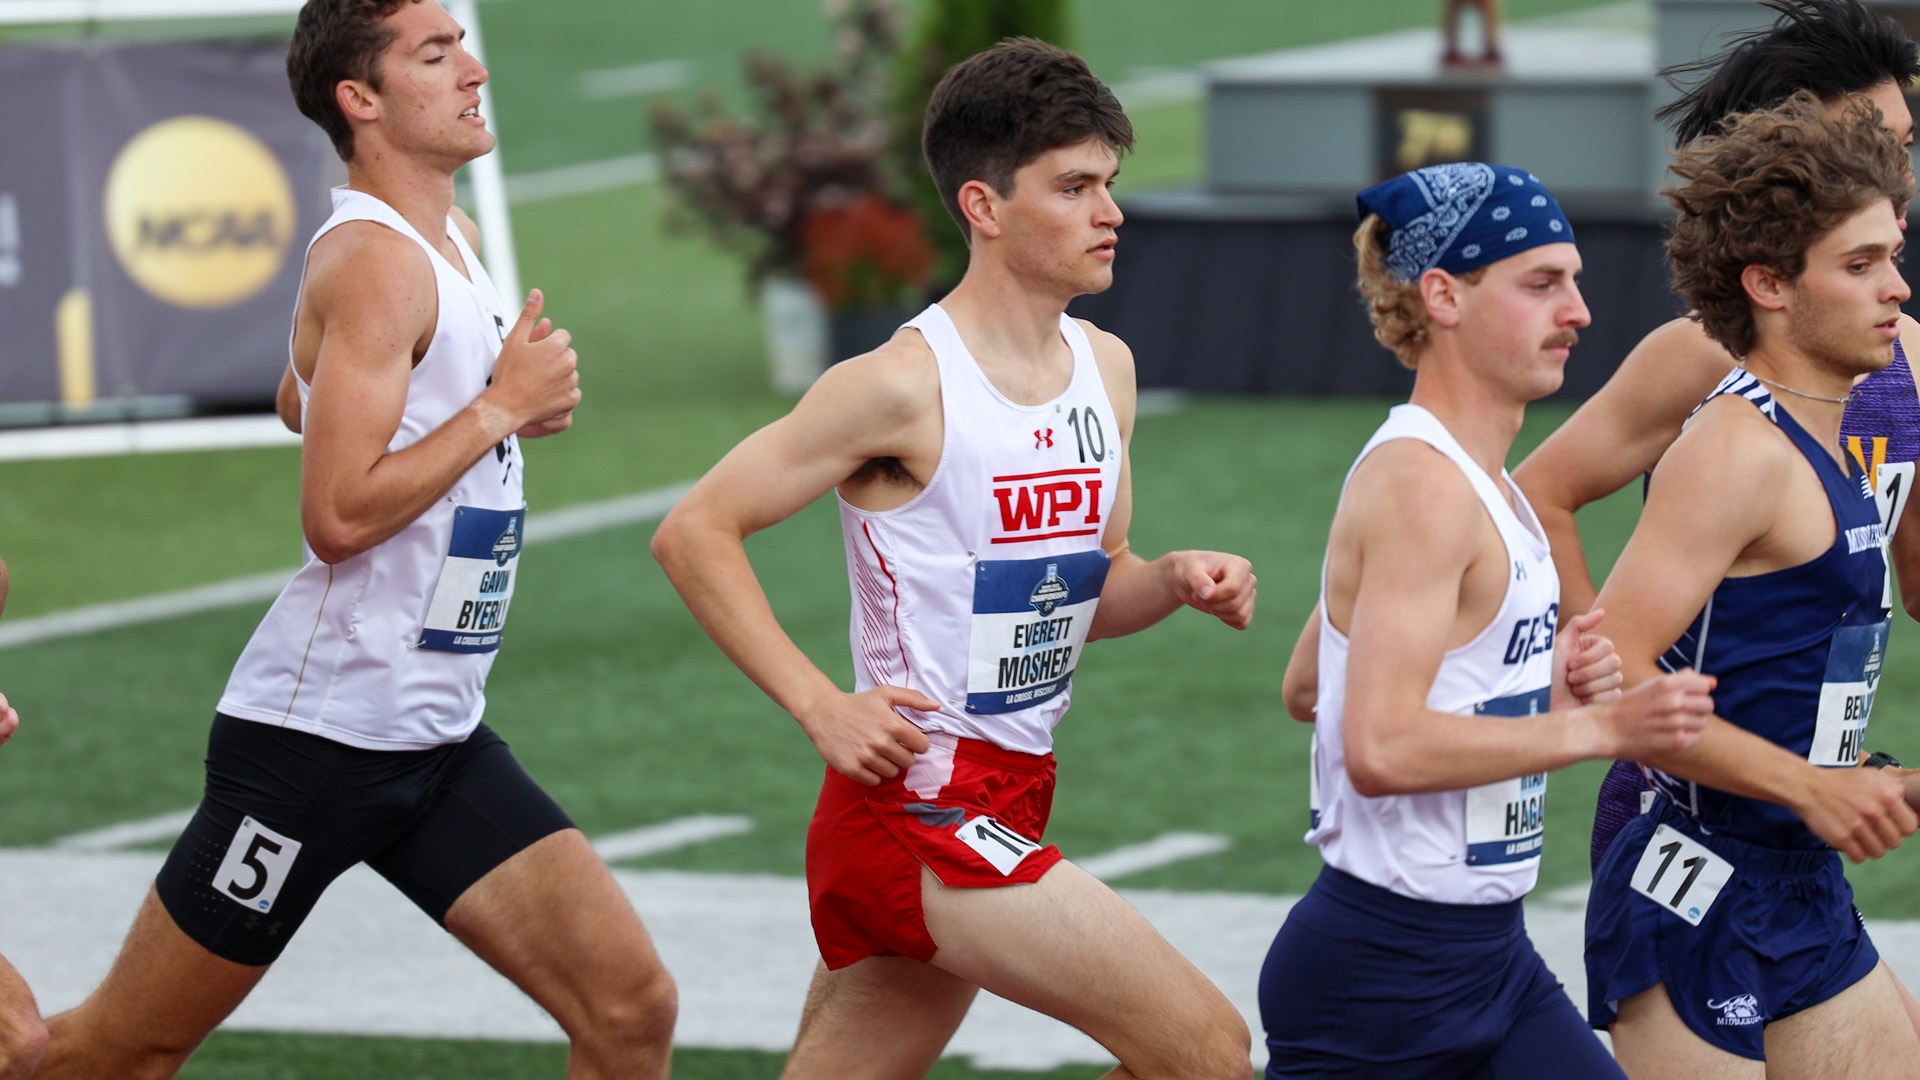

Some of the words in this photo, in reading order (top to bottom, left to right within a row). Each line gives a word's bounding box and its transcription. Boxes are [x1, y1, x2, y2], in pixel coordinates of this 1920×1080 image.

[137, 210, 277, 255] NCAA
[1067, 405, 1106, 464] 10
[993, 479, 1103, 532] WPI
[1013, 616, 1073, 649] EVERETT
[997, 646, 1073, 689] MOSHER
[227, 832, 283, 900] 5
[1646, 840, 1708, 909] 11
